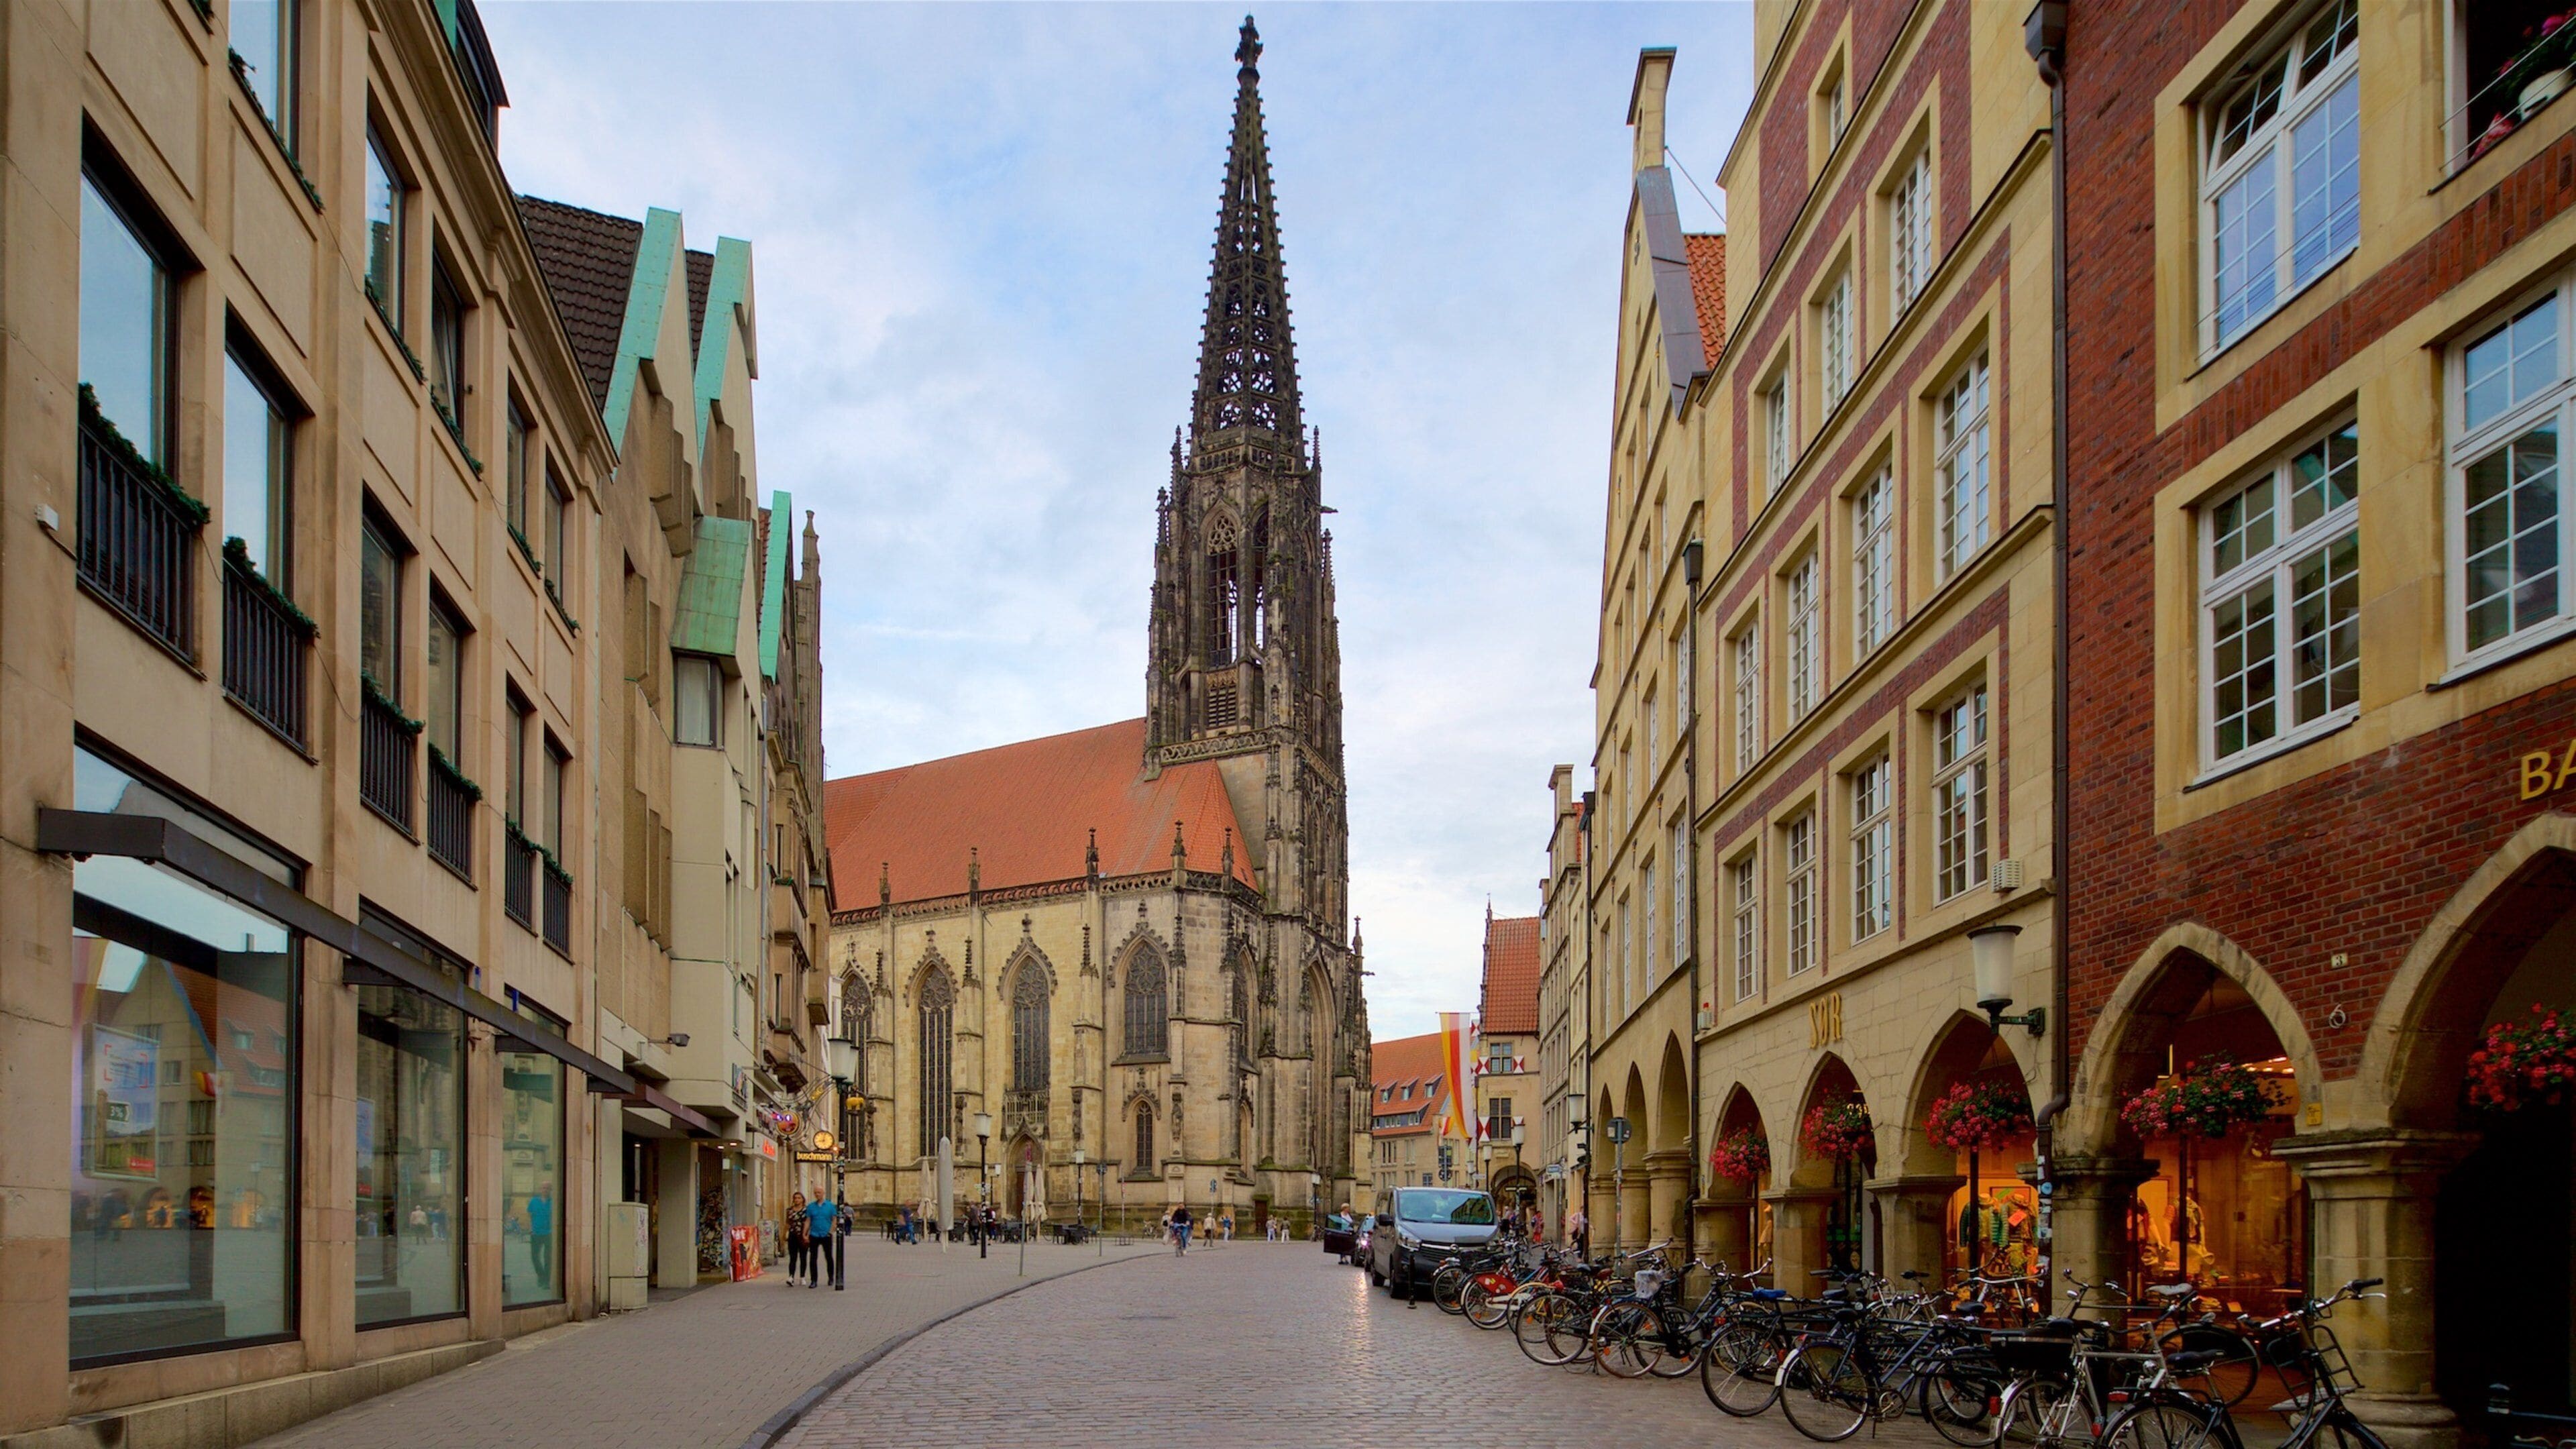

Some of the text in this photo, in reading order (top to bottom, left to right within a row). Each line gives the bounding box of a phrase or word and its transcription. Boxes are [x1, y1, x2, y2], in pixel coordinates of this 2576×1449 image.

[2334, 955, 2343, 967] 3
[1809, 992, 1841, 1050] SØR
[109, 1105, 124, 1118] 3%
[796, 1151, 833, 1161] buschmann
